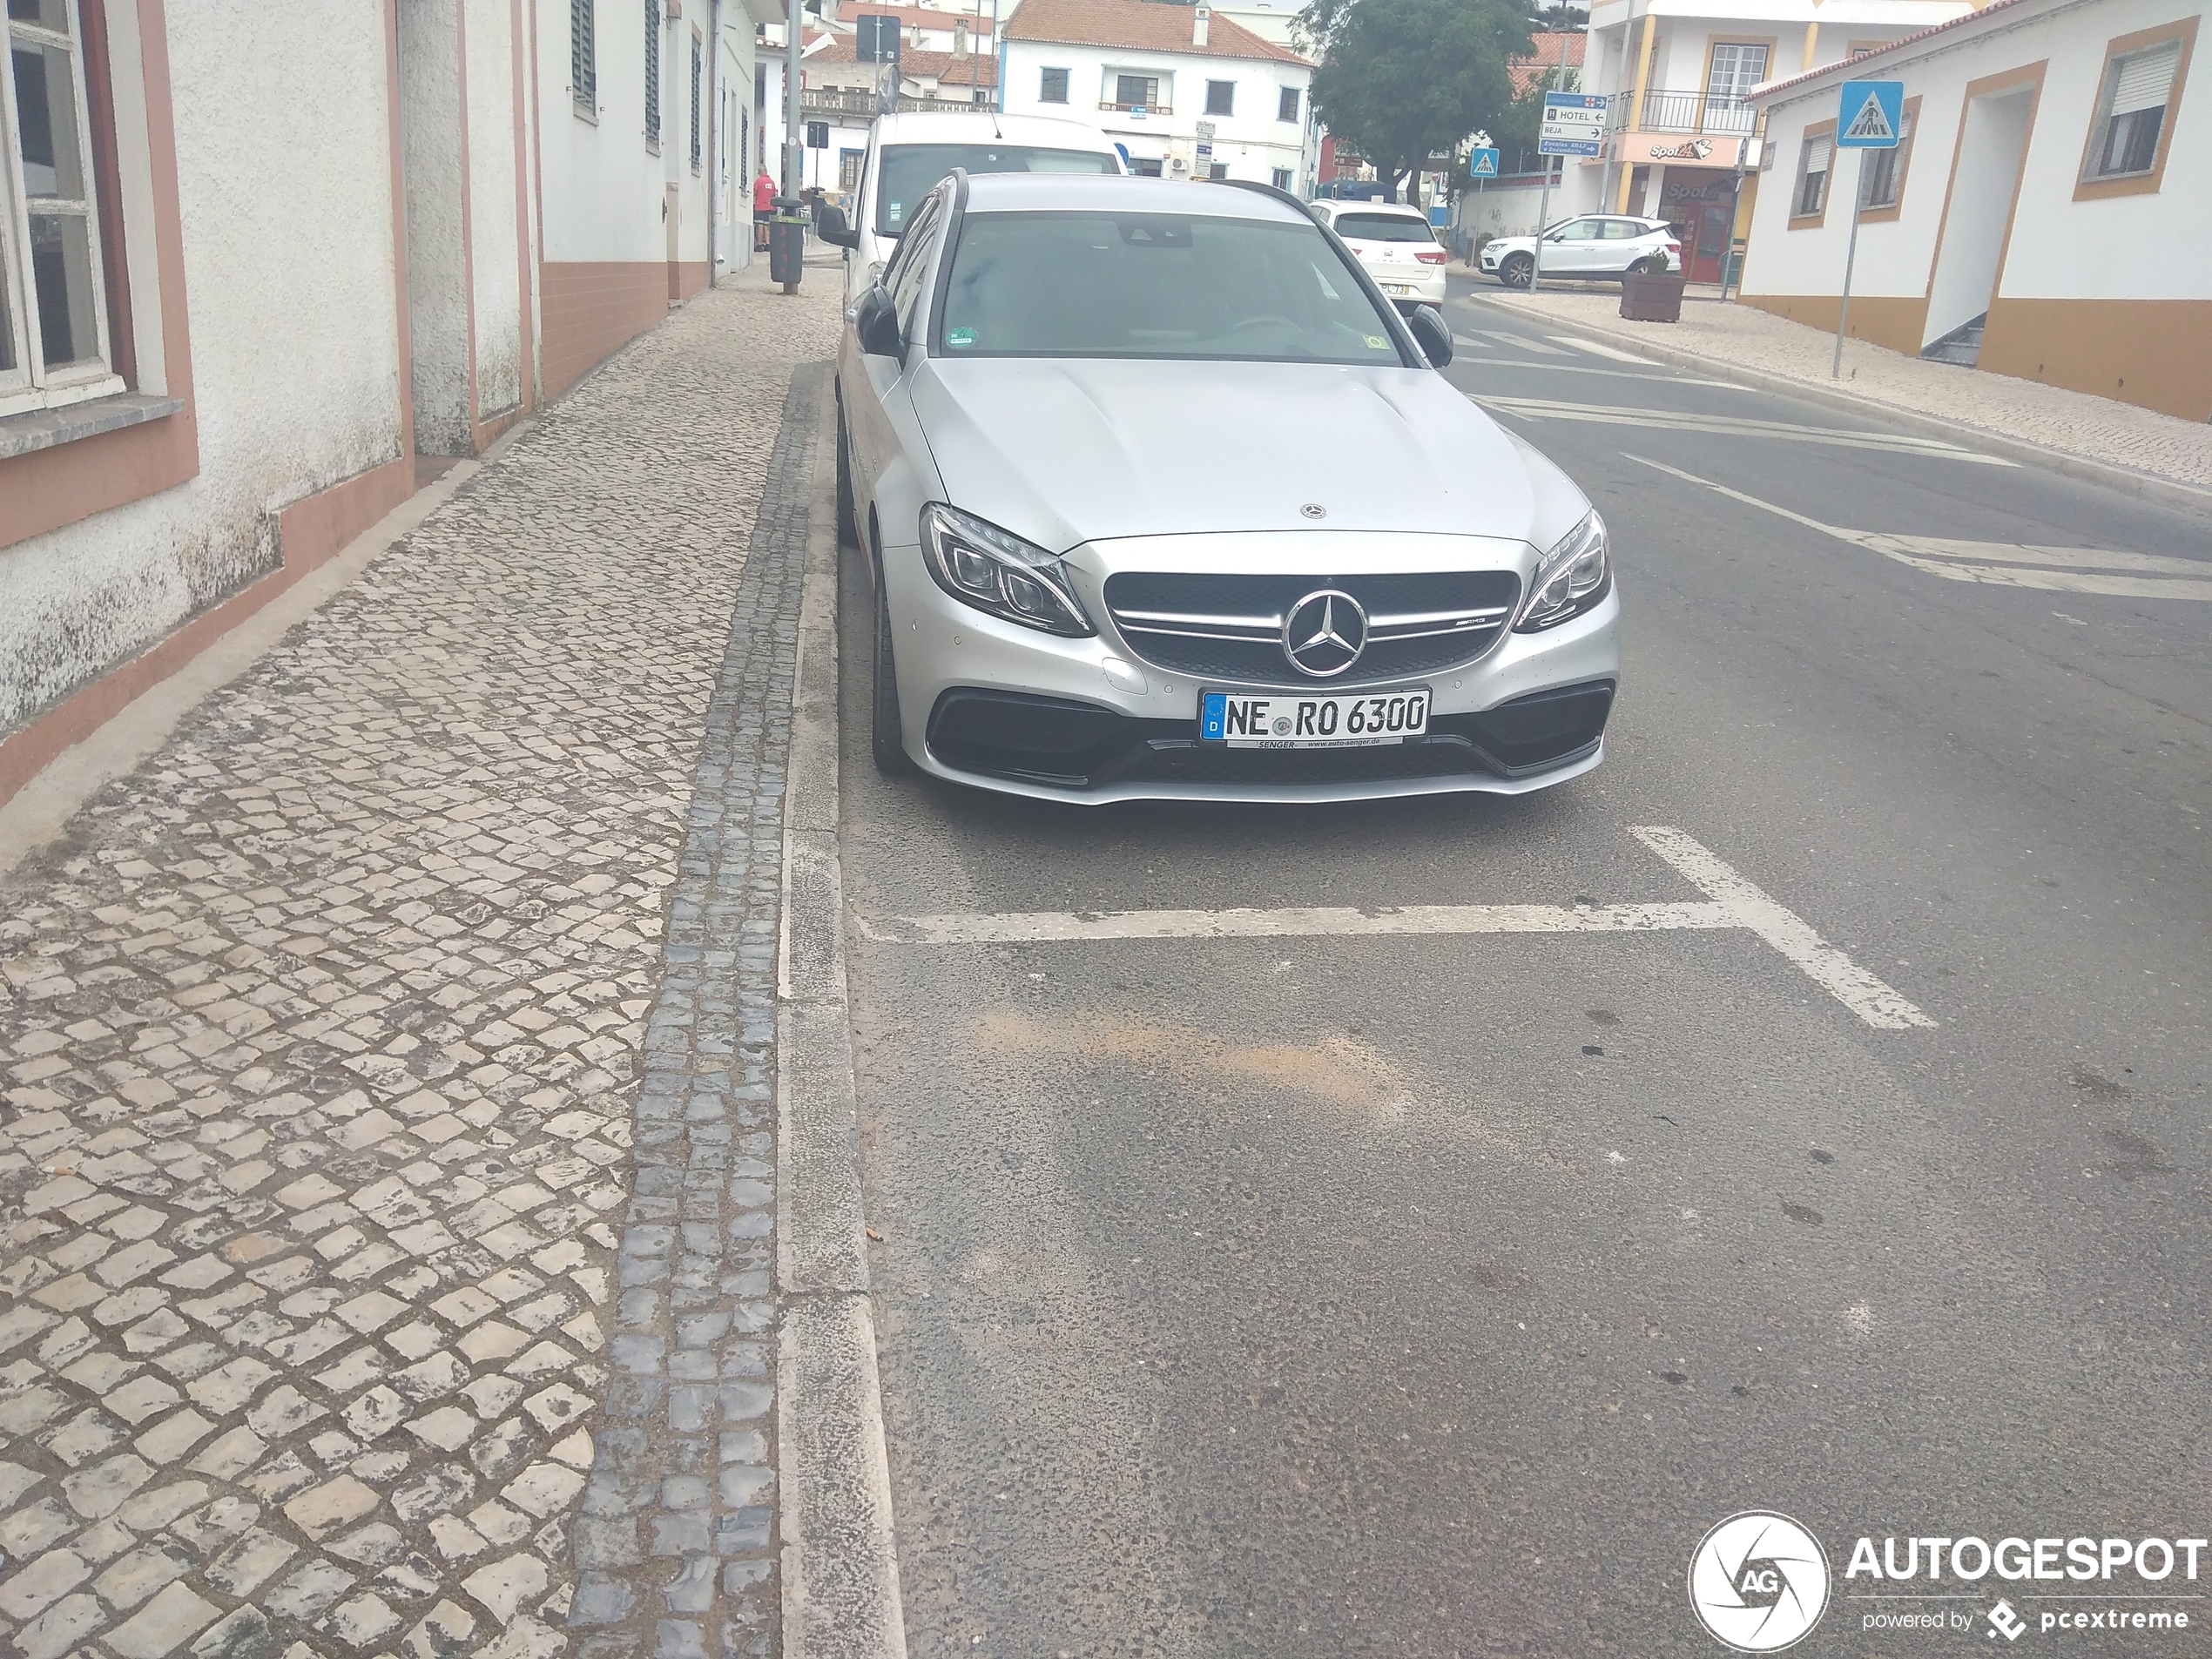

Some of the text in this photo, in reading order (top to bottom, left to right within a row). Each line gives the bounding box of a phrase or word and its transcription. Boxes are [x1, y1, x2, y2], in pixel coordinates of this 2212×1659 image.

[1561, 111, 1589, 120] HOTEL
[1209, 697, 1424, 736] D NE RO 6300
[1308, 738, 1380, 747] www.auto-senger.de
